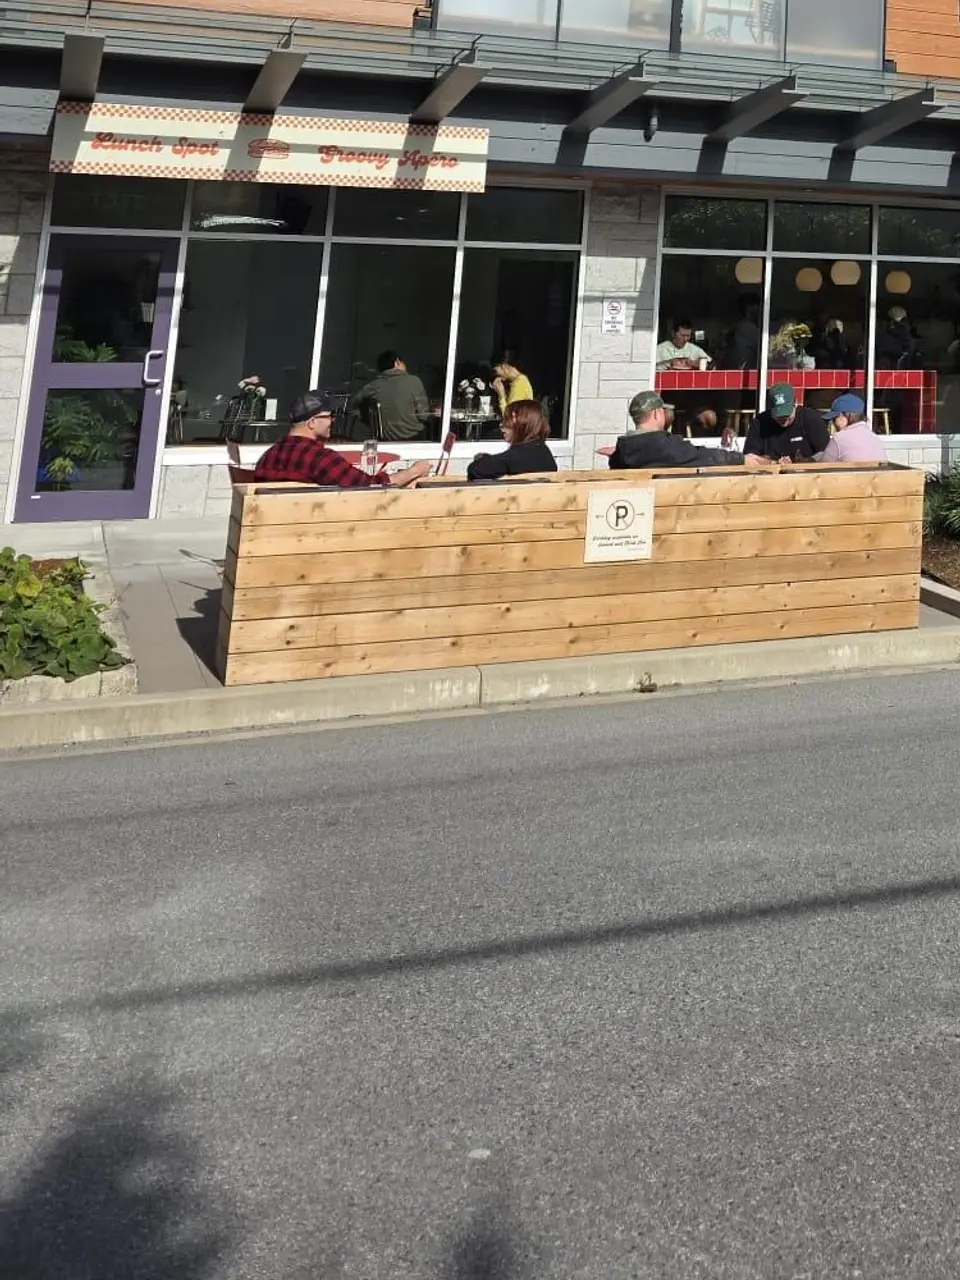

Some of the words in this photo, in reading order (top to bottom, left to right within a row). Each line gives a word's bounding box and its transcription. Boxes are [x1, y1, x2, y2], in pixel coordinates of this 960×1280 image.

[91, 132, 164, 152] Lunch
[172, 136, 219, 158] Spot
[318, 145, 390, 170] Groovy
[615, 505, 628, 527] P
